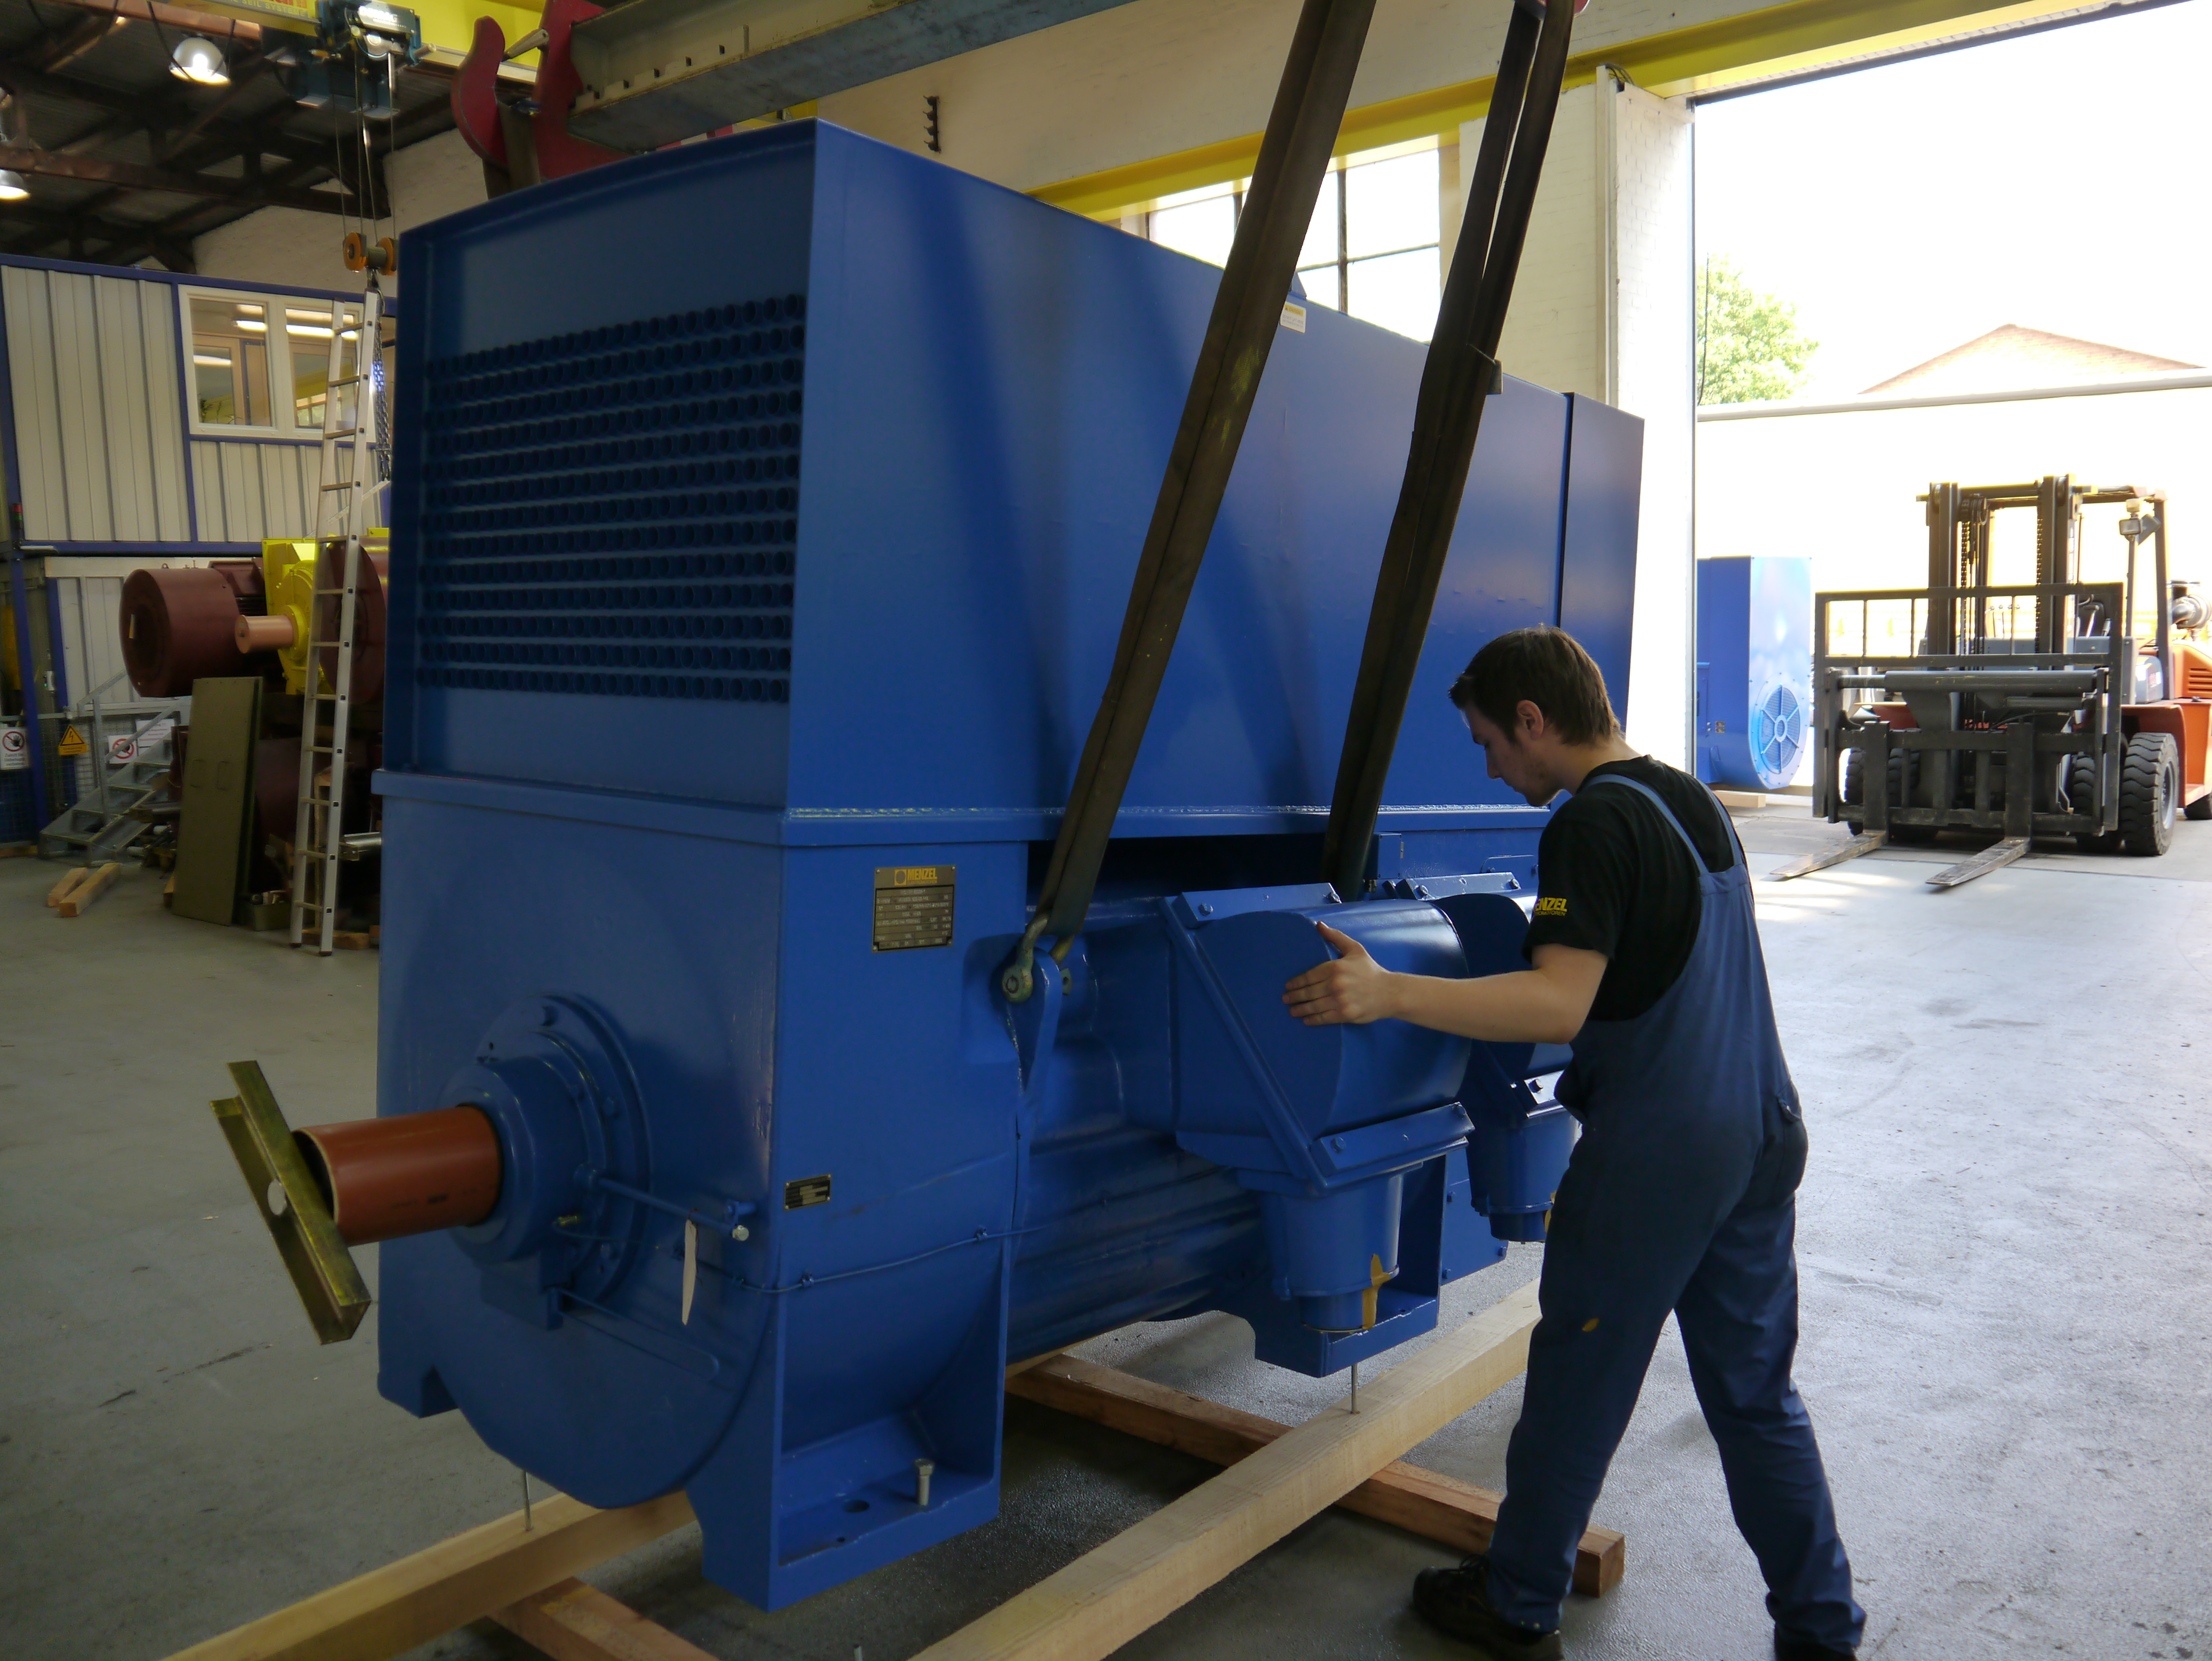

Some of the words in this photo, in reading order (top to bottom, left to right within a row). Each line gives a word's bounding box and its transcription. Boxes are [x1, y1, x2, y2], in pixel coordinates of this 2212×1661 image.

[265, 4, 305, 16] SYSTEME
[908, 868, 937, 880] MENZEL
[1535, 897, 1567, 911] ENZEL
